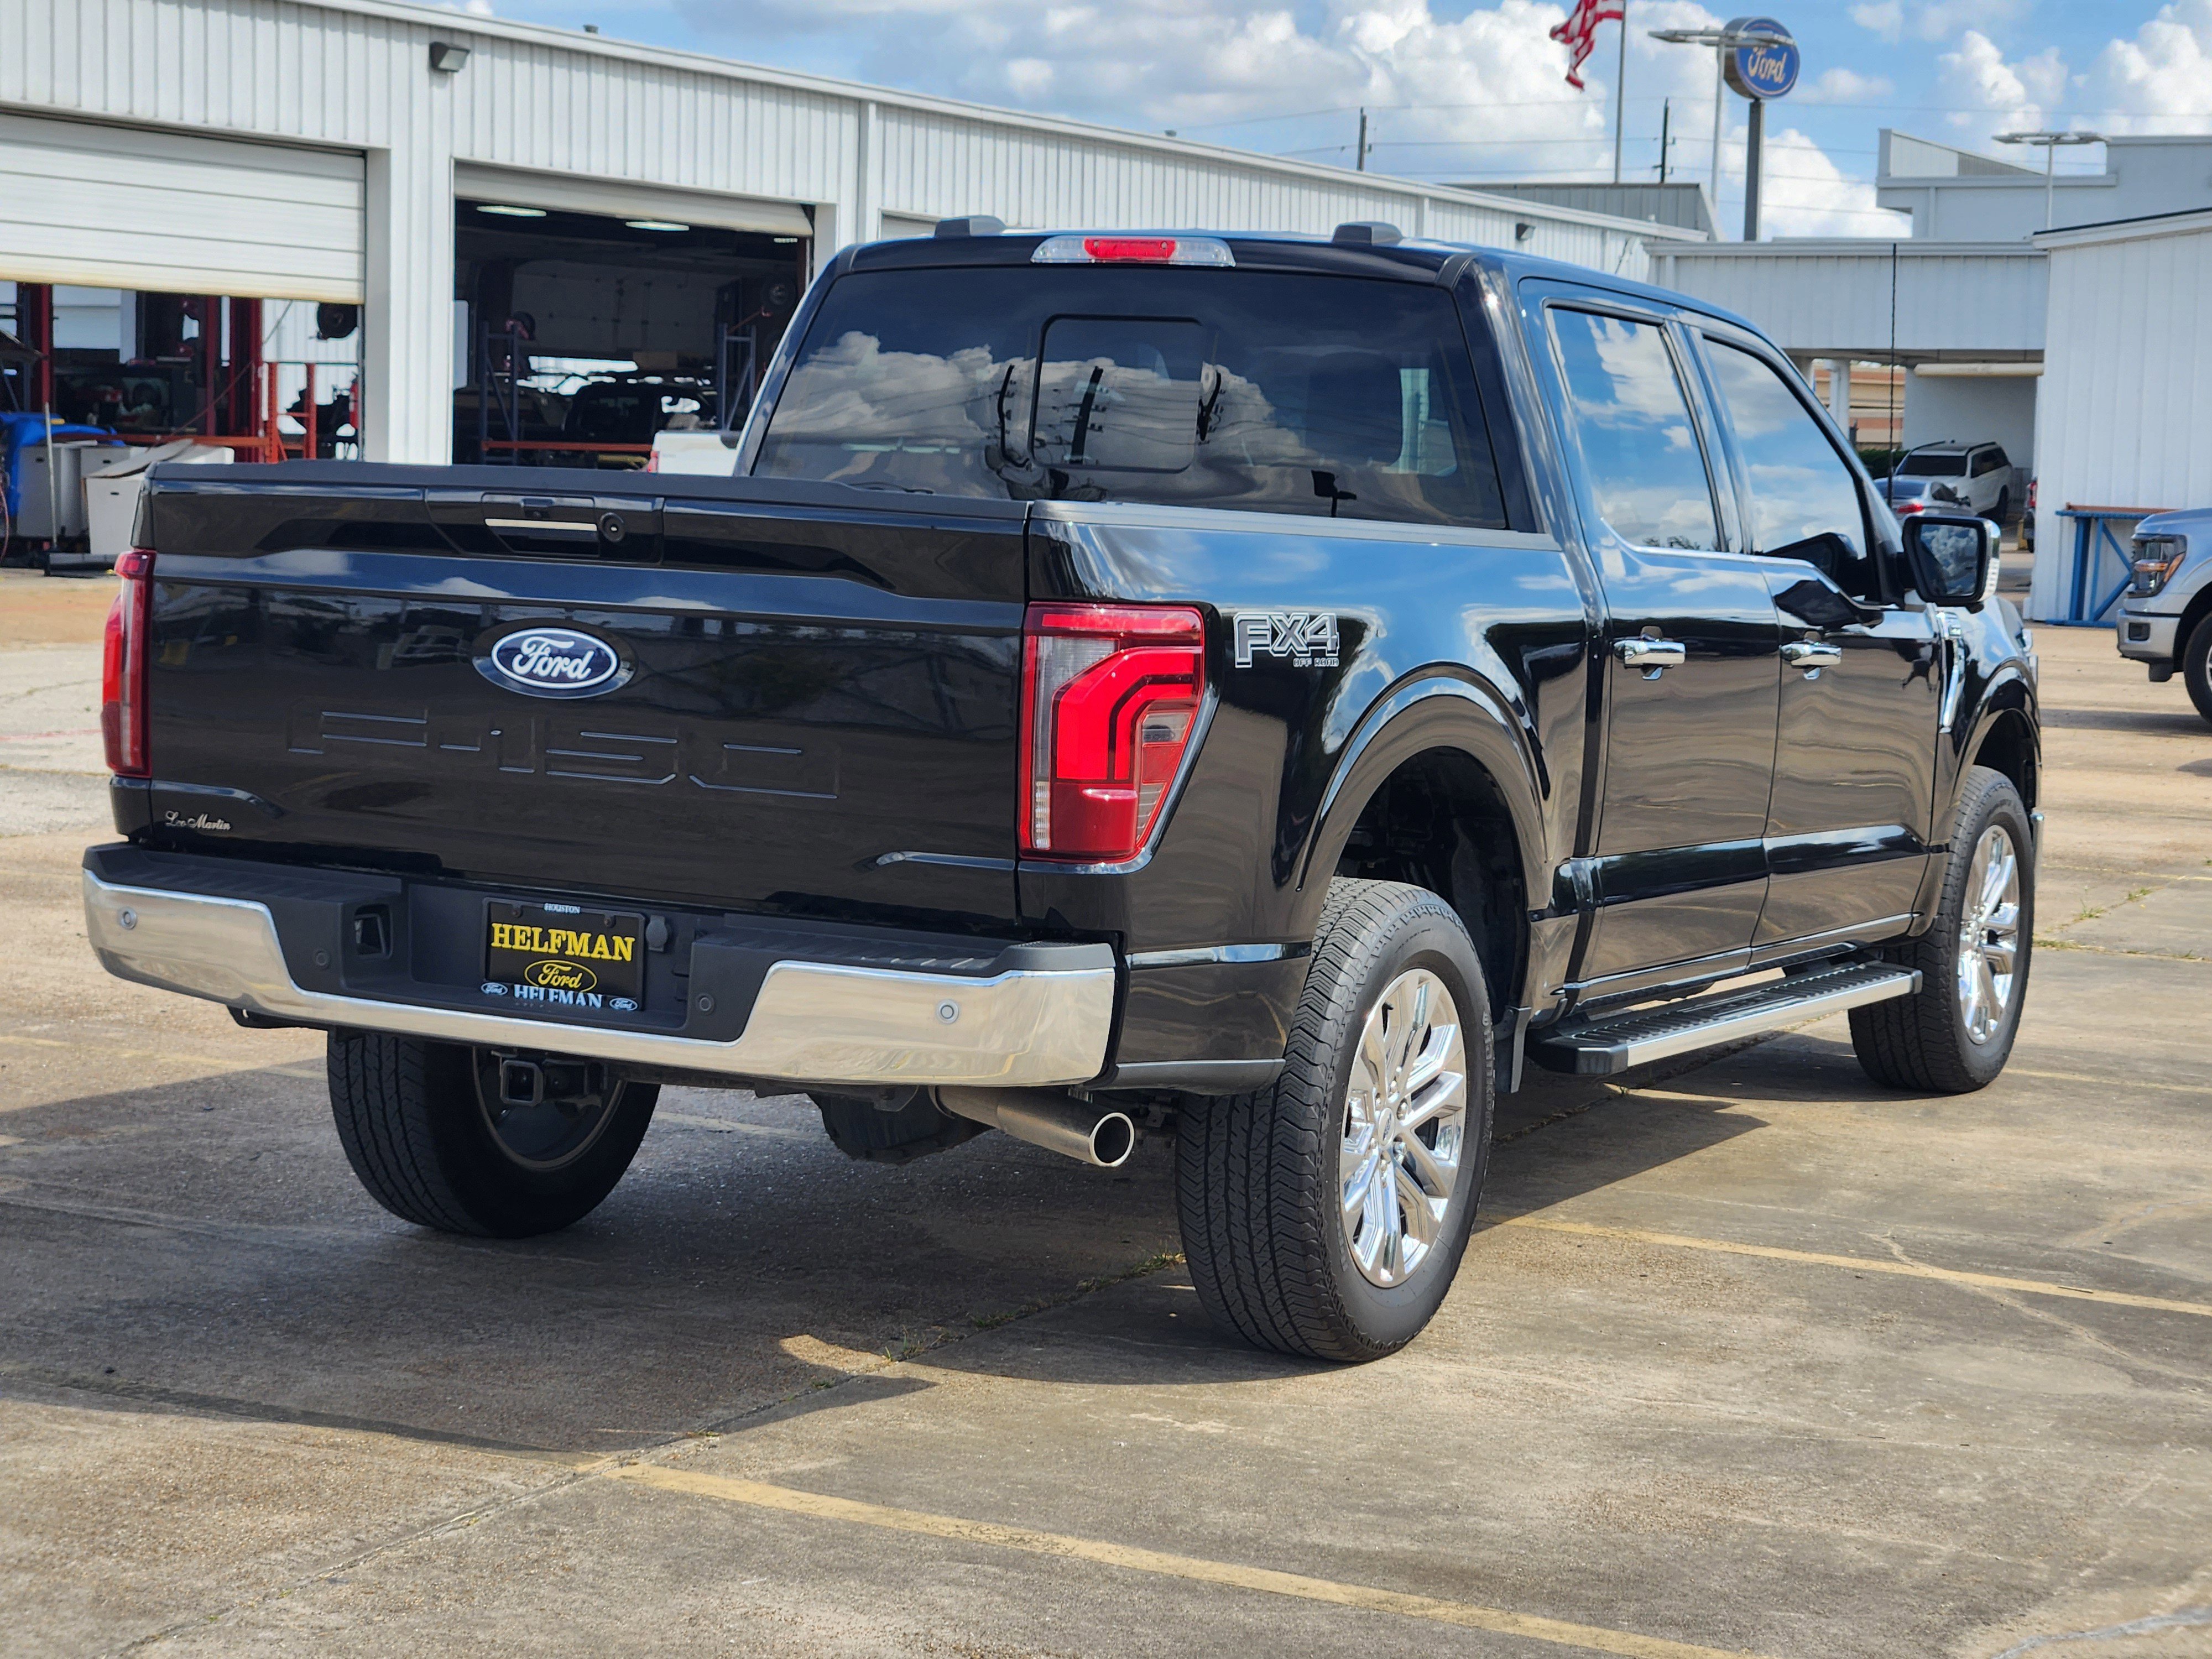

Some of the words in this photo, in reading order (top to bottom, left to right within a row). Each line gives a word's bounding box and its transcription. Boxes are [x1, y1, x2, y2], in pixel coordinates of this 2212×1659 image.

[1748, 47, 1787, 83] Ford
[1233, 612, 1339, 668] FX4
[512, 637, 595, 679] Ford
[1293, 658, 1312, 667] OFF
[1314, 658, 1339, 667] ROAD
[187, 814, 231, 830] Martin
[544, 903, 580, 913] HOUSTON
[492, 923, 635, 961] HELFMAN
[538, 963, 582, 988] Ford
